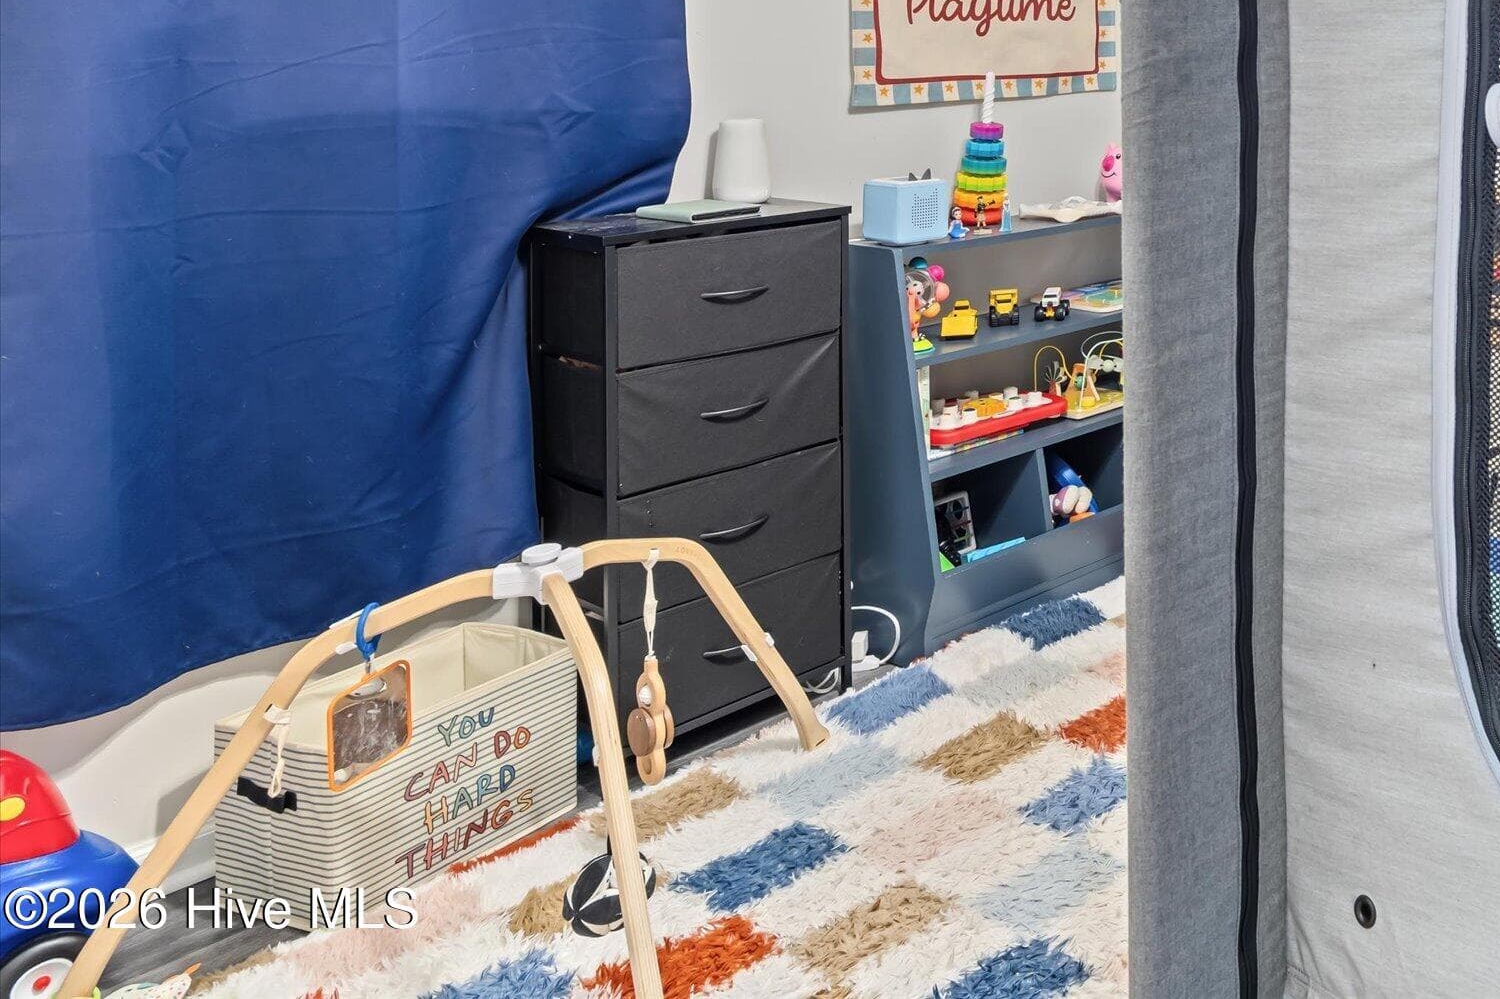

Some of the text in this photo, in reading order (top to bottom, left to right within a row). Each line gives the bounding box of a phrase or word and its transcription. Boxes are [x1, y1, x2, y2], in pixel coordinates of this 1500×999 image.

[436, 707, 495, 747] YOU
[403, 726, 531, 801] CAN DO
[423, 764, 516, 834] HARD
[394, 788, 534, 879] THINGS
